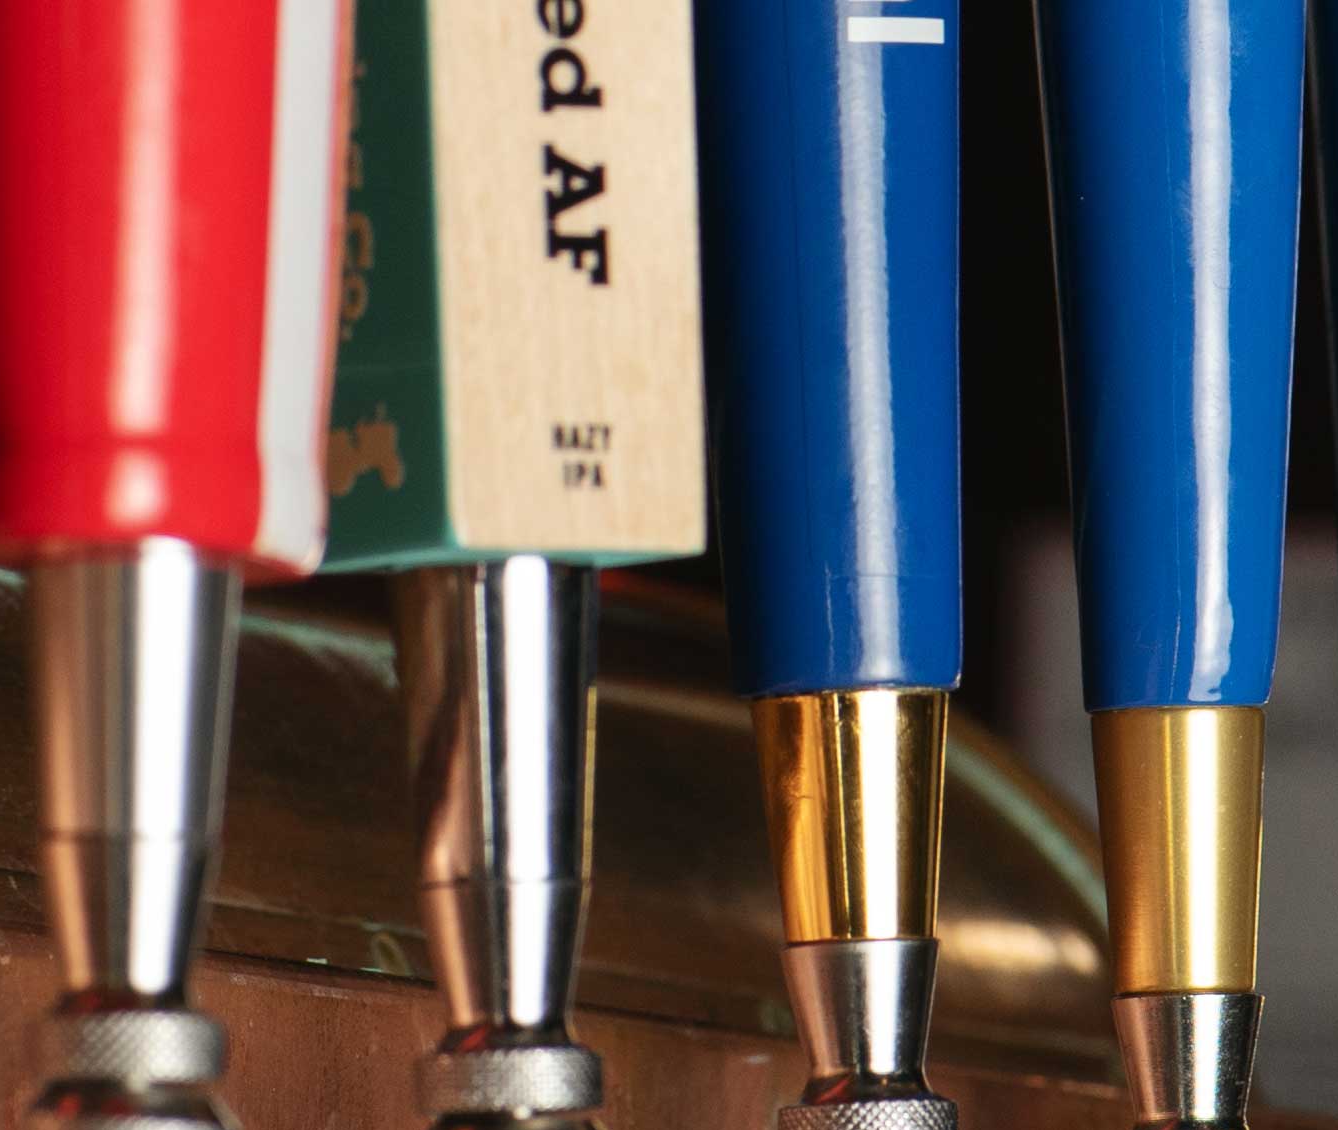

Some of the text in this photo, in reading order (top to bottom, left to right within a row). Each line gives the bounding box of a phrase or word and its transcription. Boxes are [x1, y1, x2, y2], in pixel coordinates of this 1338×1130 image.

[542, 146, 609, 286] AF
[551, 423, 612, 451] HAZY
[563, 462, 606, 489] IPA
